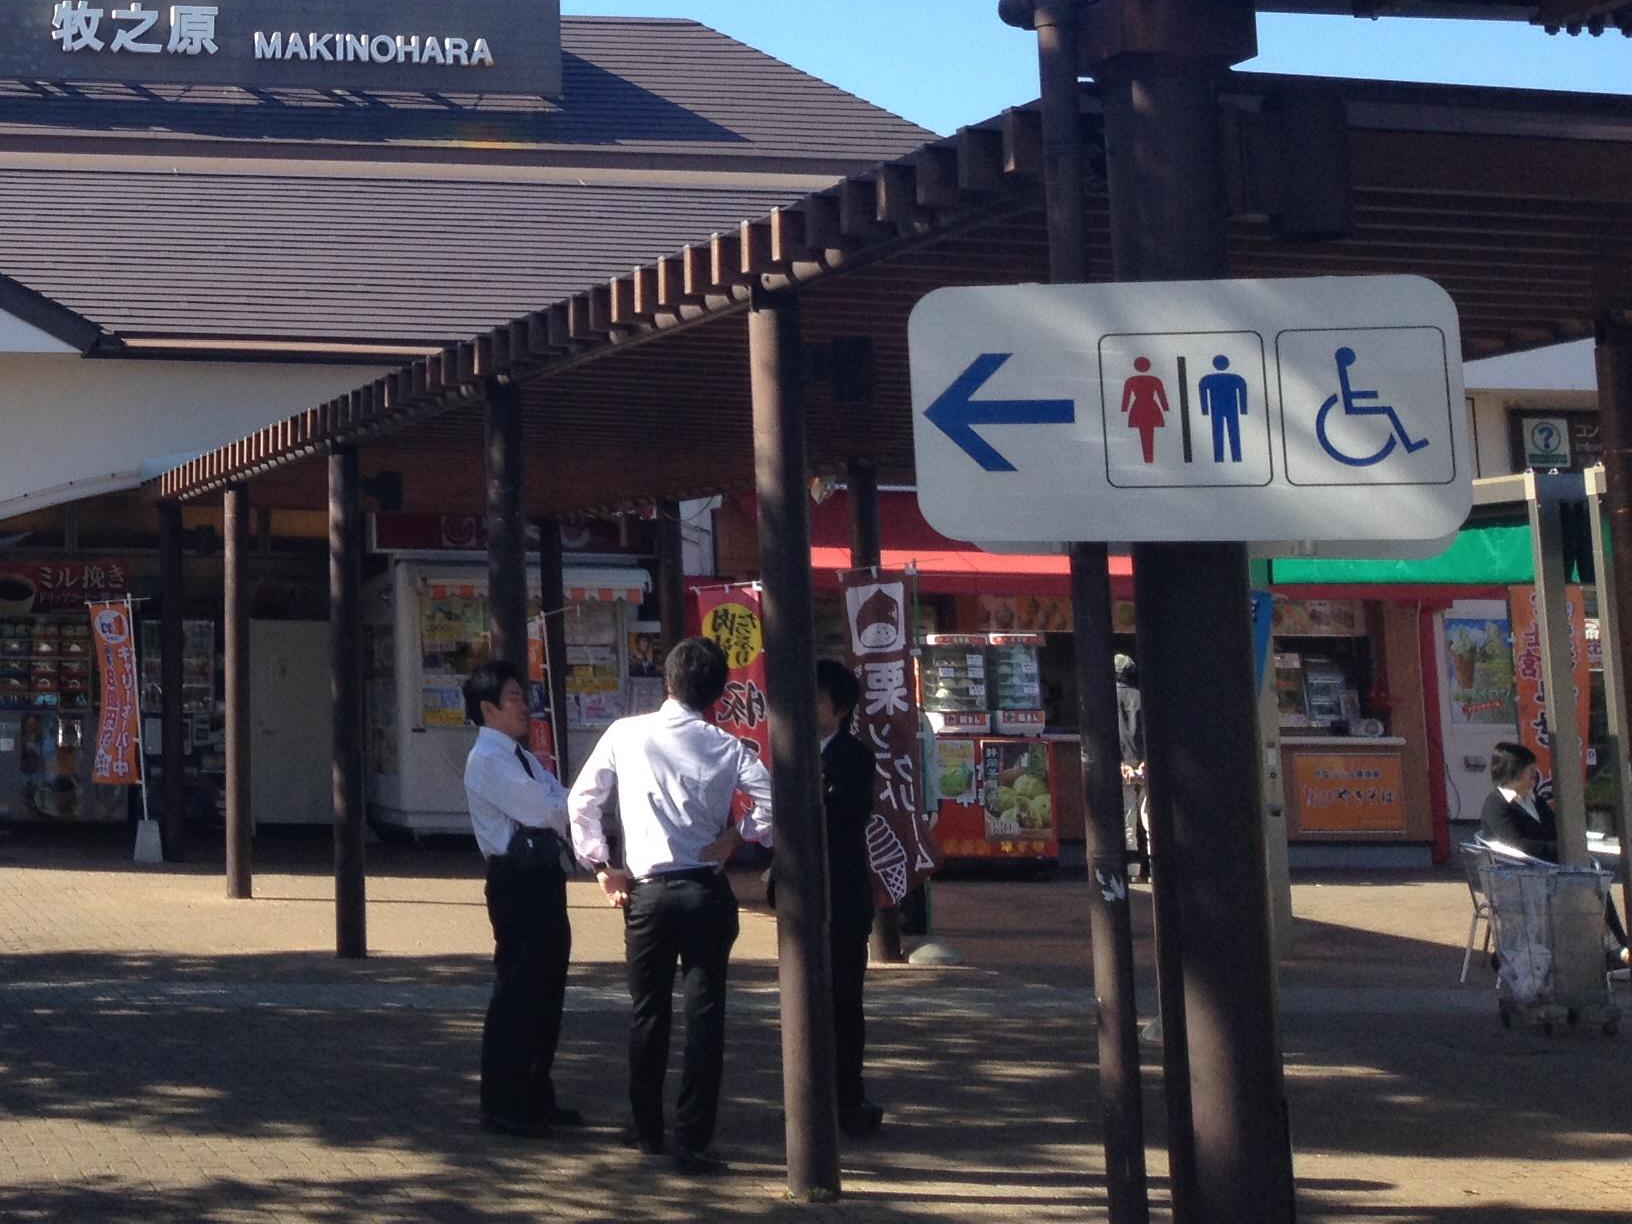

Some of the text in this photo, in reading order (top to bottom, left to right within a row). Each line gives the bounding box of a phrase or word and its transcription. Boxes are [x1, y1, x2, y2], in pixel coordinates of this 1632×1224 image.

[51, 0, 219, 56] 牧之原
[253, 30, 495, 66] MAKINOHARA
[39, 564, 125, 589] ミル挽き
